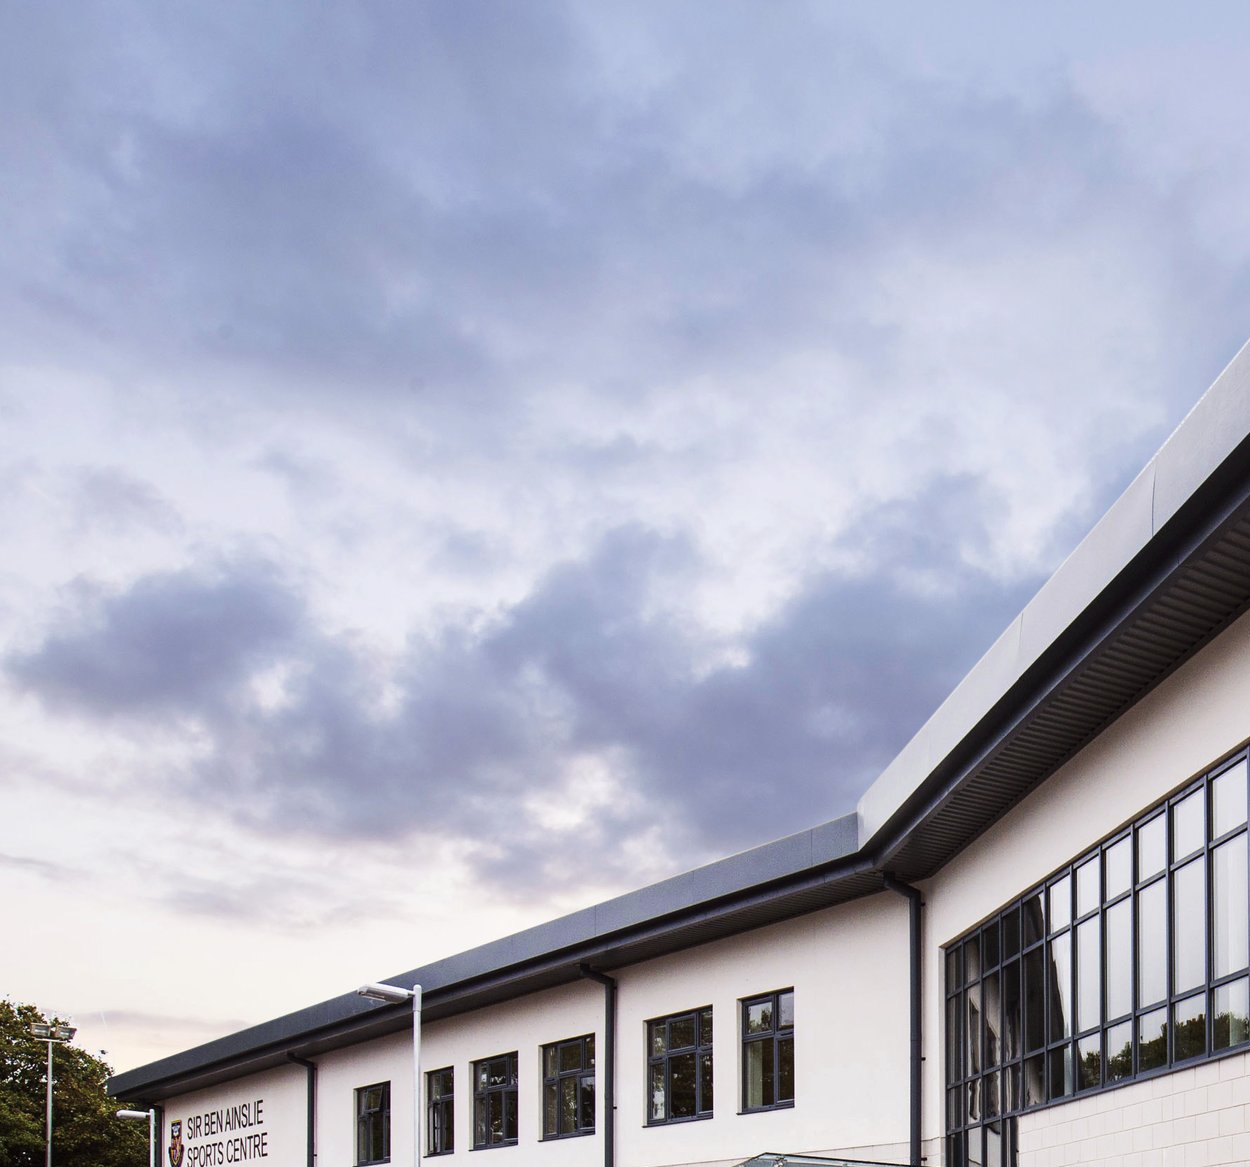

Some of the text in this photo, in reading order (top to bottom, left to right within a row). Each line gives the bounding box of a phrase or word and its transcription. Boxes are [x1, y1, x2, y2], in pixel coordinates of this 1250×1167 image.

[187, 1099, 263, 1140] SIR BEN AINSLIE
[226, 1132, 268, 1163] CENTRE
